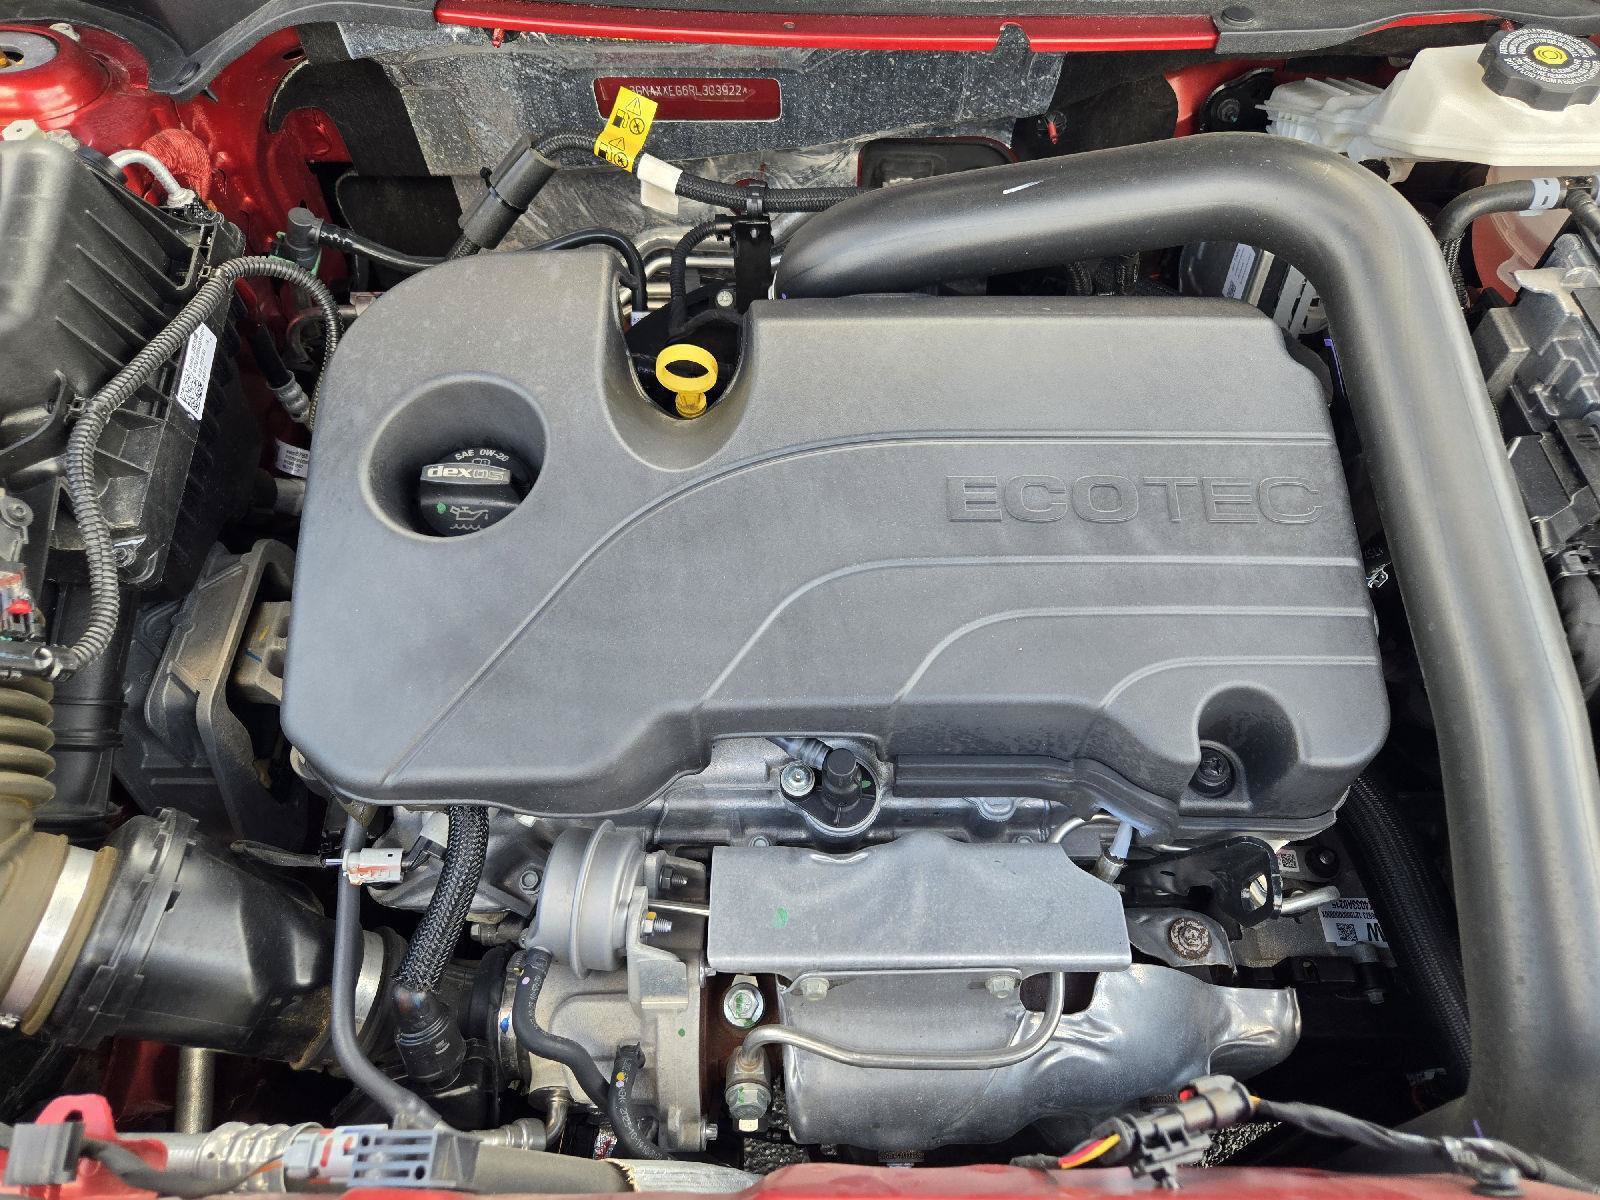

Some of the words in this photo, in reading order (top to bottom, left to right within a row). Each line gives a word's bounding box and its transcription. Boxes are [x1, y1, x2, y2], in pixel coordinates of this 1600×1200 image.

[1519, 68, 1537, 78] FLUID
[1536, 75, 1557, 84] FROM
[455, 449, 475, 461] SAE
[480, 448, 510, 462] 0W-20
[427, 465, 505, 481] dexos
[946, 474, 1323, 524] ECOTEC
